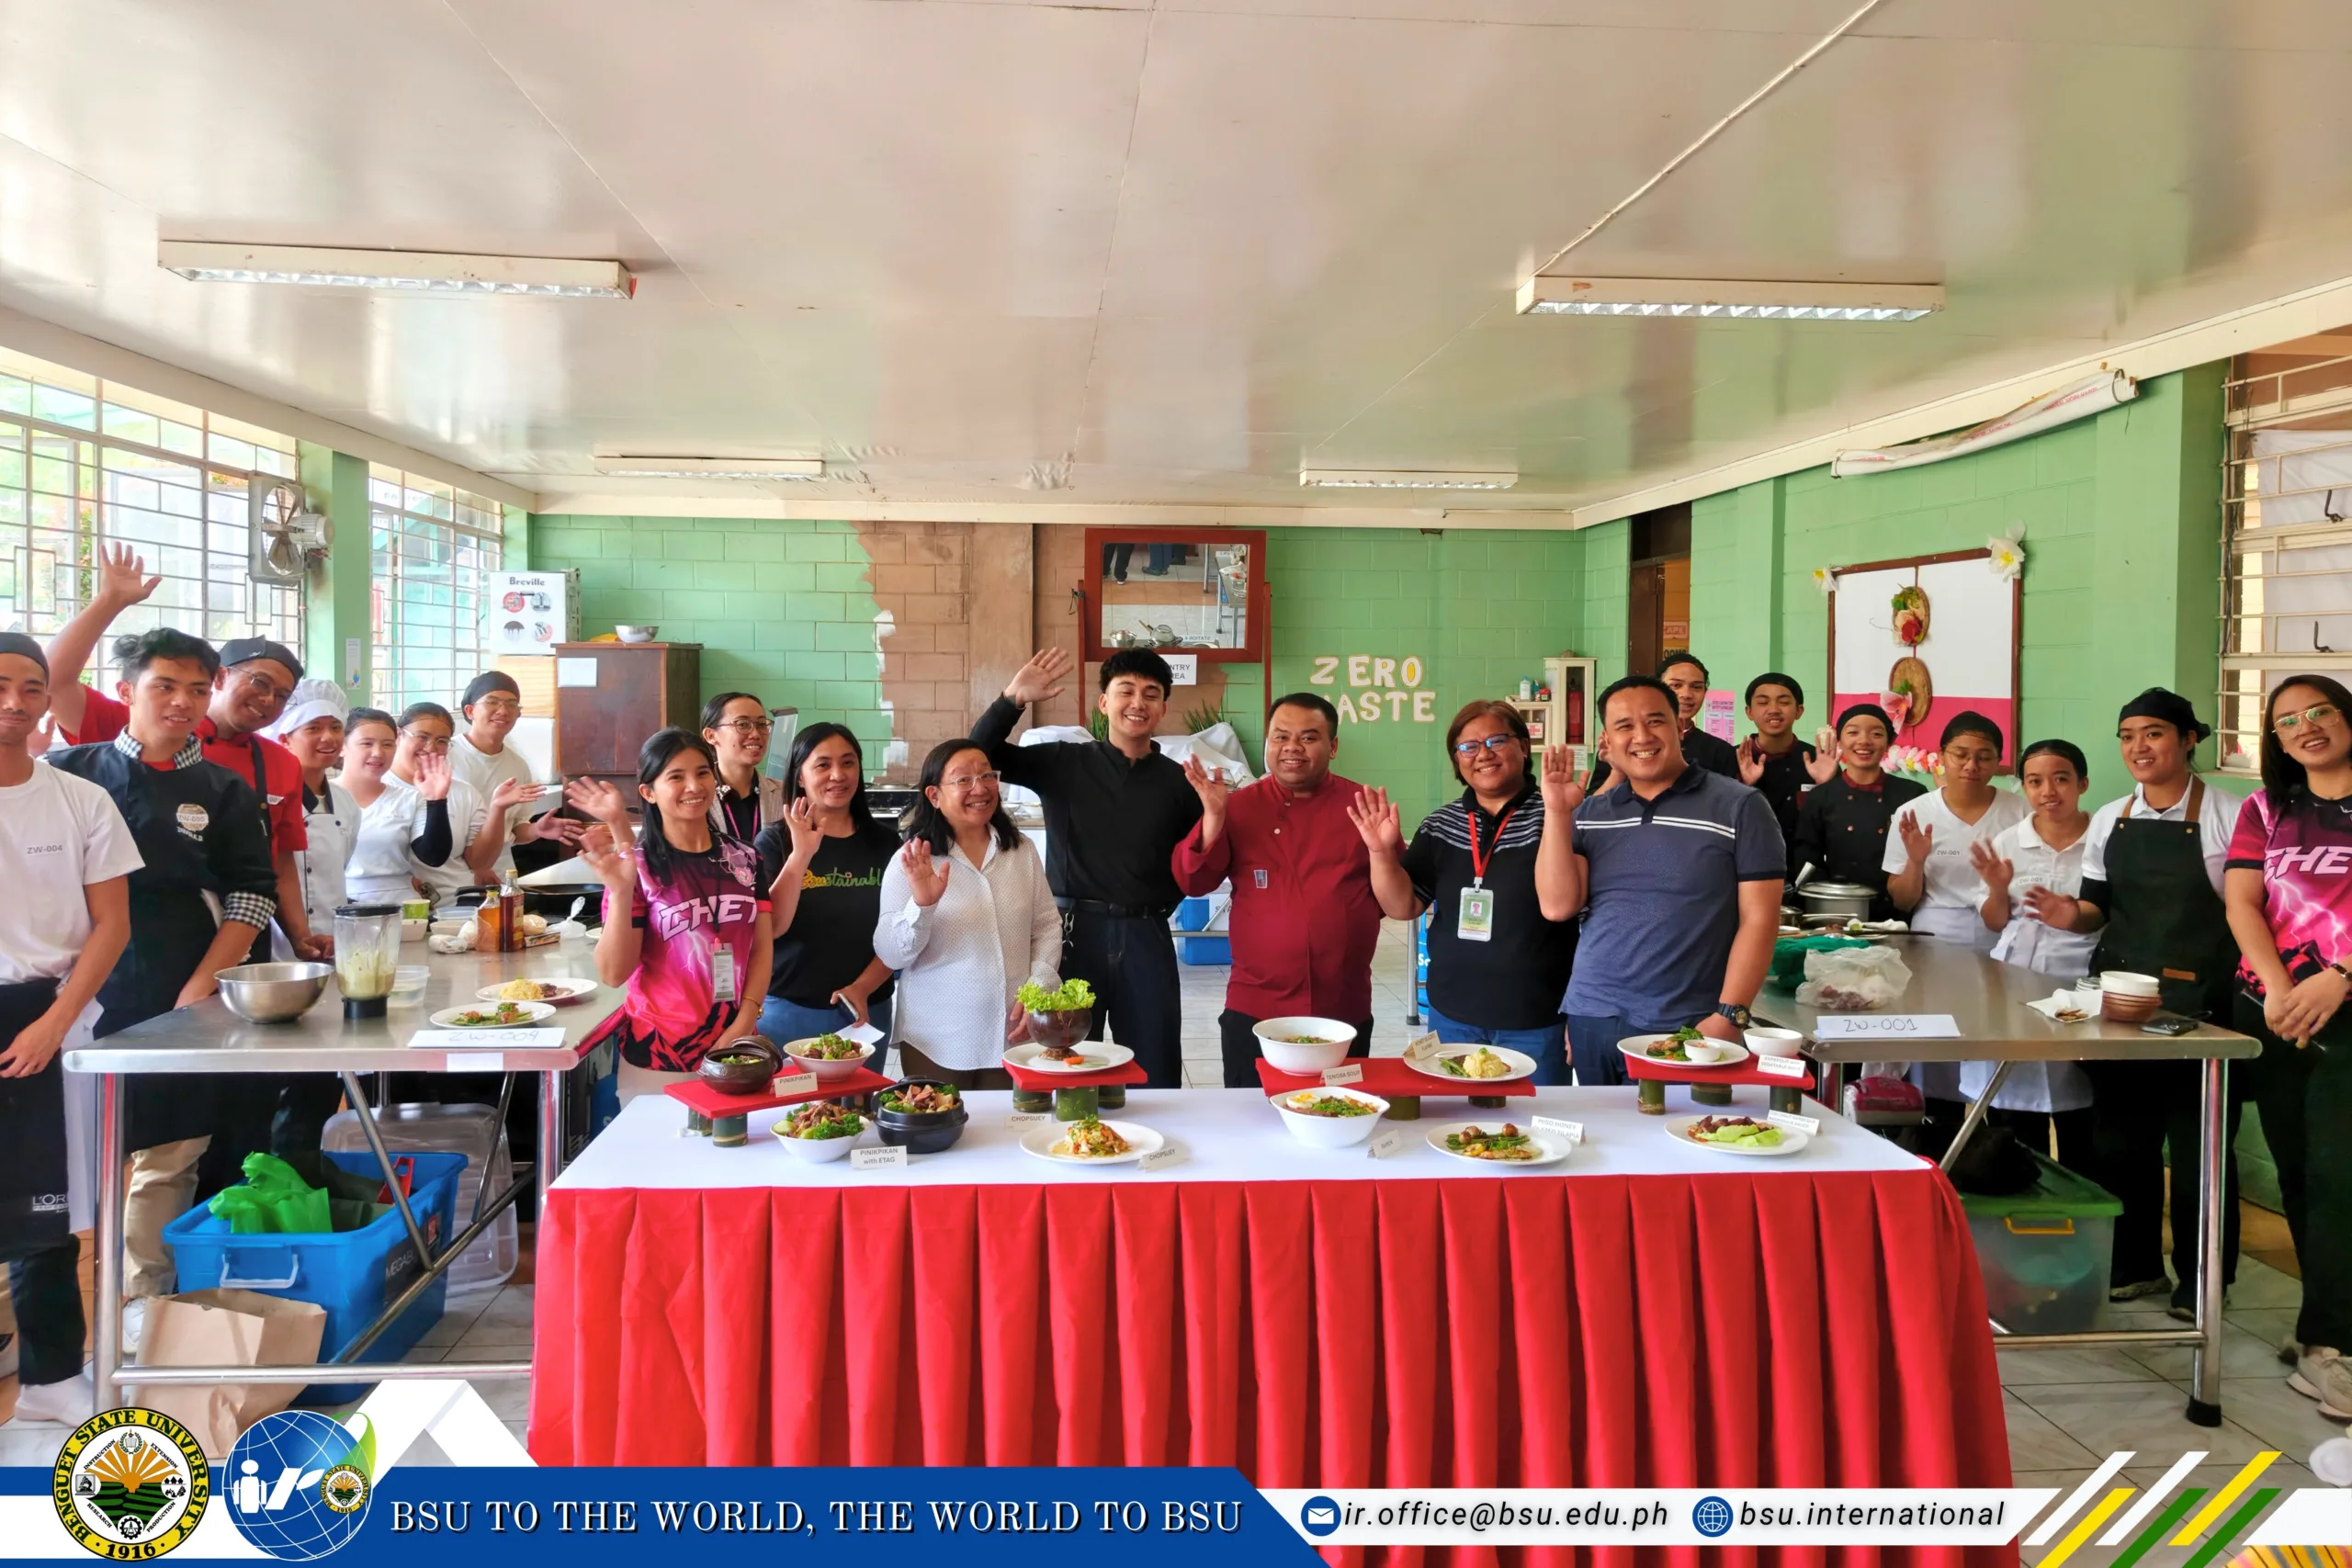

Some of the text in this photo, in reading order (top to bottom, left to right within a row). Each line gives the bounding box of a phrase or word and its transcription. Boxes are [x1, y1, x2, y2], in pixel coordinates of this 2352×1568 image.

[509, 576, 545, 586] Breville
[1310, 654, 1423, 688] ZERO
[1323, 691, 1436, 725] ASTE
[27, 844, 63, 854] ZW-004
[2264, 846, 2352, 884] CHE
[659, 893, 757, 942] CHET
[1347, 1069, 1361, 1078] SOUP
[779, 1074, 812, 1085] PINIKPIKAN
[1538, 1118, 1577, 1130] MISO HONEY
[860, 1147, 899, 1156] PINIKPIKAN
[1149, 1149, 1177, 1161] CHOPSUEY
[32, 1194, 67, 1205] L'OR
